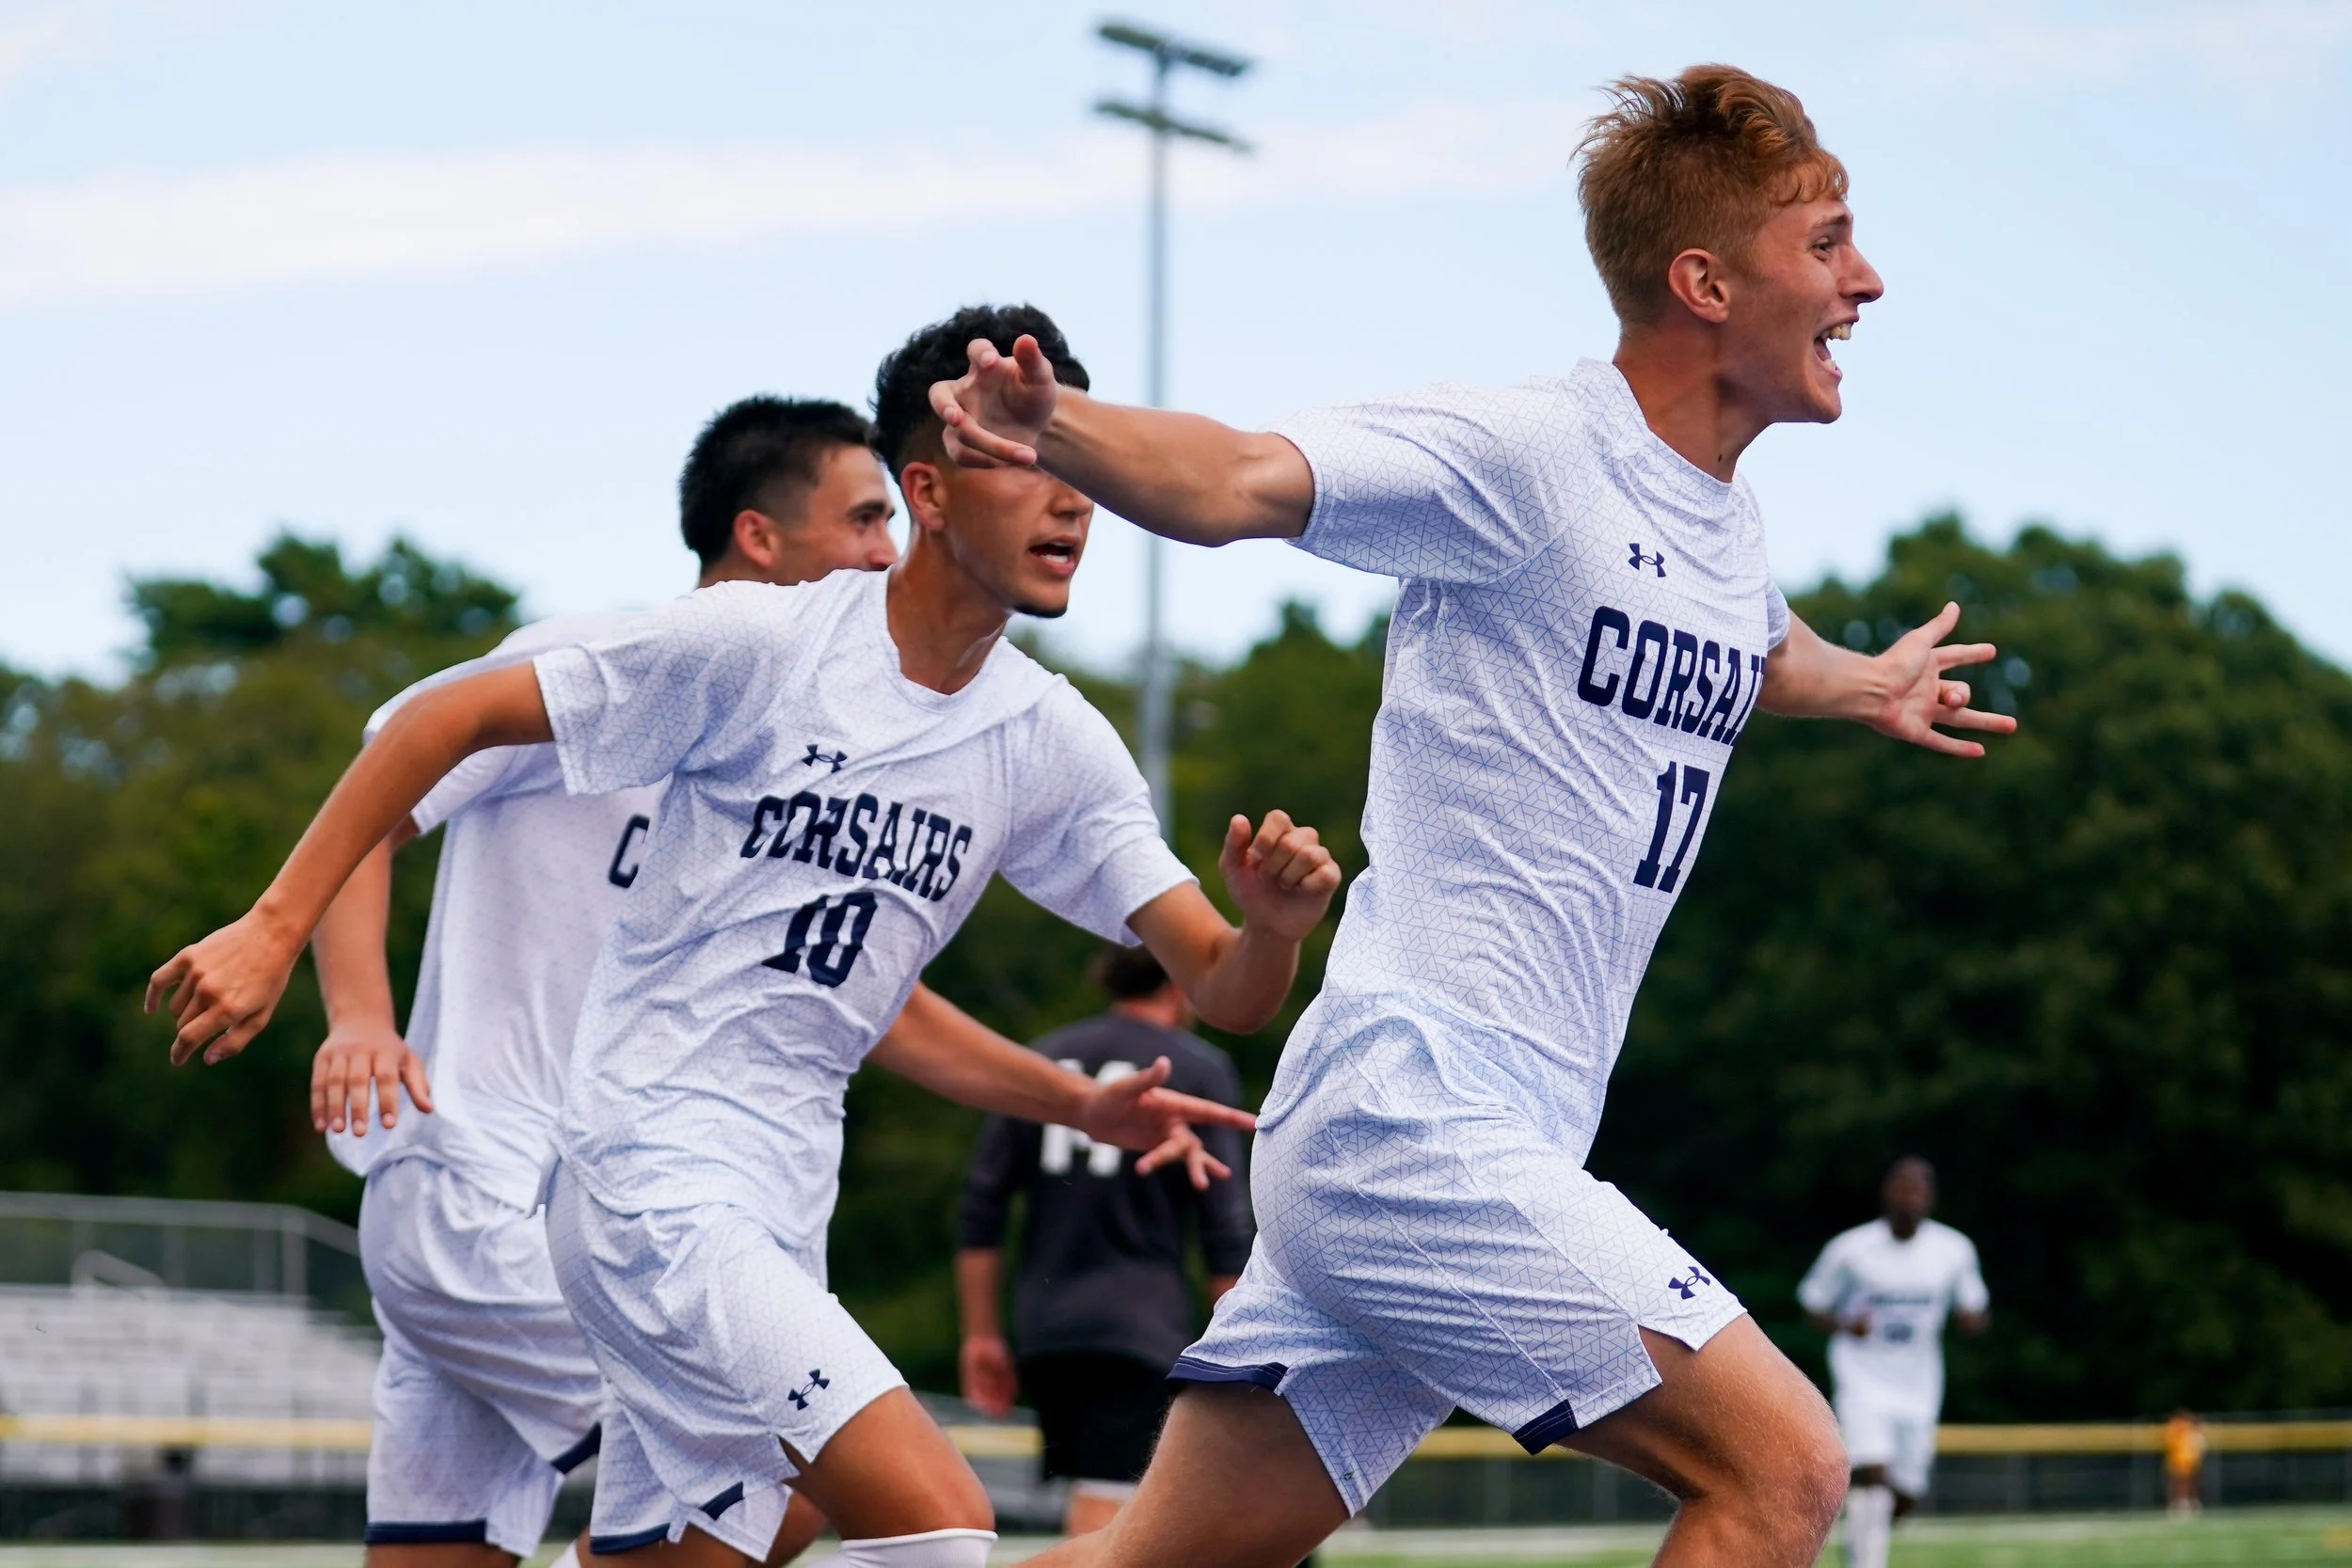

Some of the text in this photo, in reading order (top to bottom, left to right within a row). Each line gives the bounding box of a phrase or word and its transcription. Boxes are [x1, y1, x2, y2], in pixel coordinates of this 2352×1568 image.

[1578, 605, 1767, 746] CORSAI
[740, 790, 973, 902] CORSAIRS
[1633, 761, 1710, 894] 17
[760, 891, 878, 988] 10
